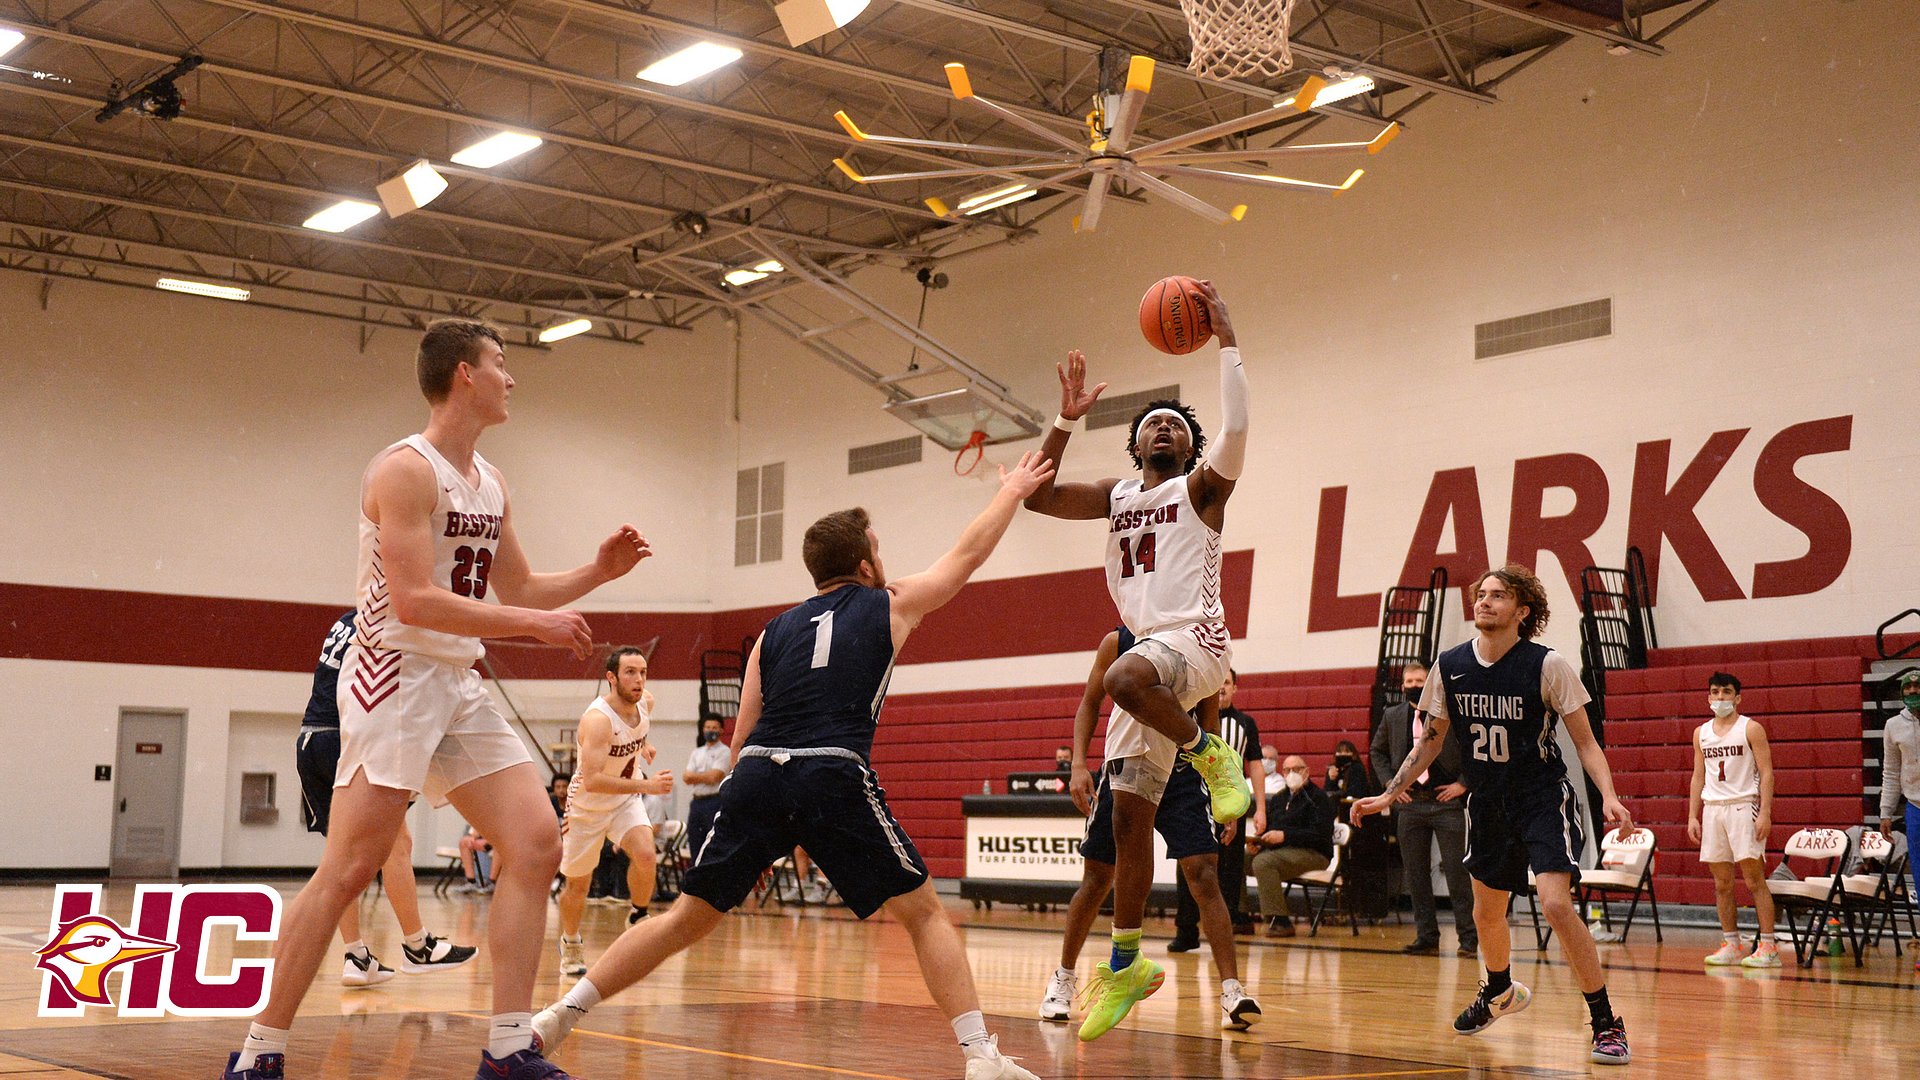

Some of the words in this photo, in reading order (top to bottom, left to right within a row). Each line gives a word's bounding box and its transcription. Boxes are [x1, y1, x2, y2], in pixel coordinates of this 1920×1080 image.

[1168, 295, 1188, 349] SPALDING
[444, 511, 503, 541] HESSTO
[1307, 414, 1853, 634] LARKS
[1119, 532, 1156, 579] 14
[451, 545, 493, 600] 23
[810, 609, 835, 669] 1
[1454, 693, 1524, 721] STERLING
[1469, 723, 1510, 763] 20
[620, 755, 636, 779] 4
[1718, 760, 1726, 782] 1
[978, 836, 1084, 854] HUSTLER
[1610, 834, 1647, 845] LRKS
[1795, 836, 1839, 850] LARKS
[978, 855, 1006, 863] TURF
[1012, 856, 1084, 865] EQUIPMENT
